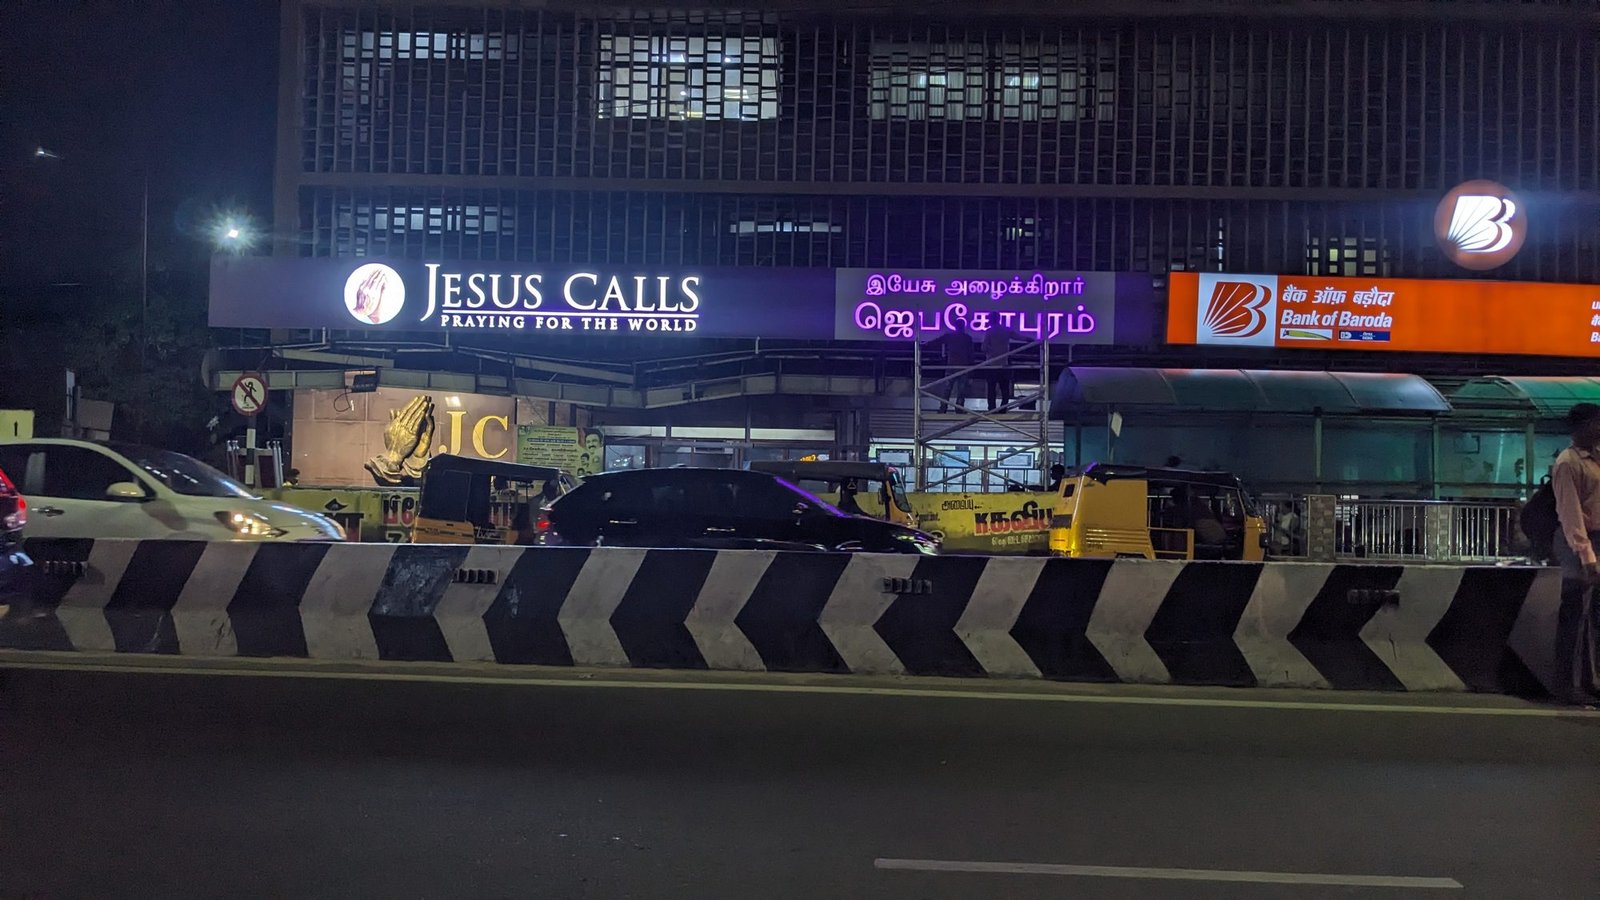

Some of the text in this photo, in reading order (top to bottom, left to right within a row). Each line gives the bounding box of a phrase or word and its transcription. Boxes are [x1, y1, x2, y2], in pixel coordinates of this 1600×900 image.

[420, 263, 701, 321] JESUS CALLS
[865, 273, 1085, 301] இயேசு அழைக்கிறார்
[1282, 284, 1395, 307] बैंक ऑफ़ बड़ौदा
[440, 314, 698, 334] PRAYING FOR THE WORLD
[1281, 309, 1393, 328] Bank of Baroda
[439, 411, 509, 459] JC
